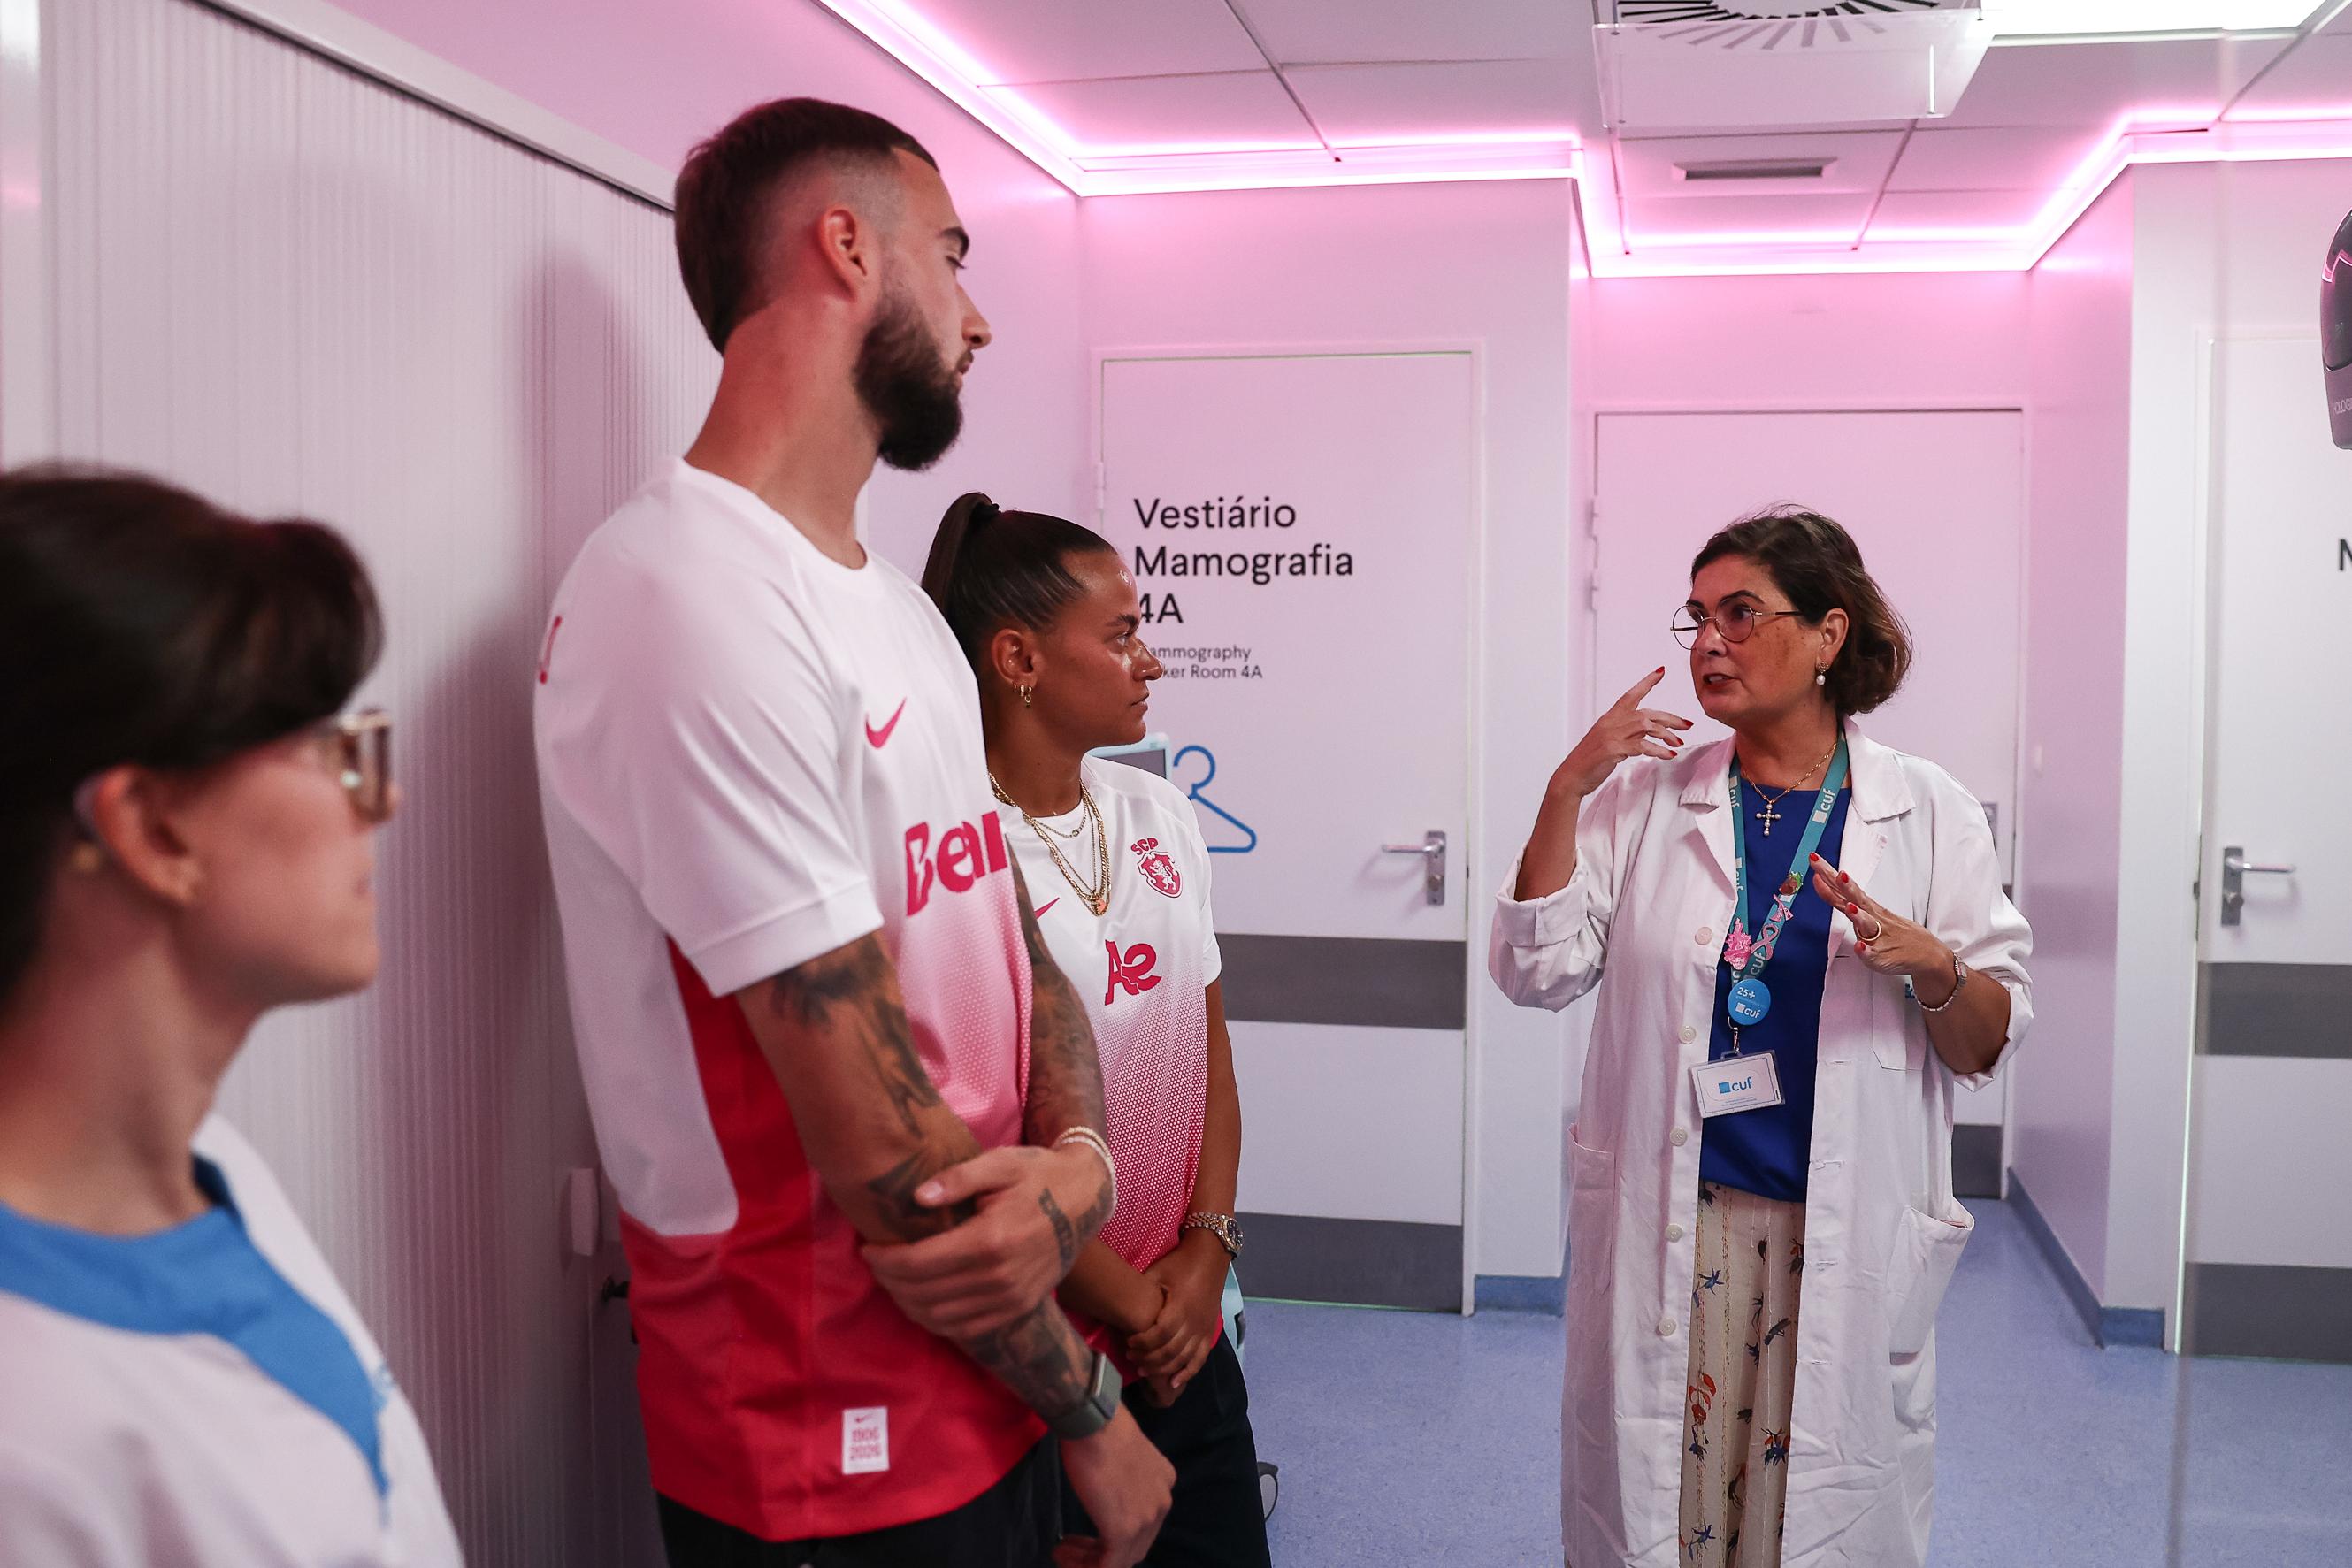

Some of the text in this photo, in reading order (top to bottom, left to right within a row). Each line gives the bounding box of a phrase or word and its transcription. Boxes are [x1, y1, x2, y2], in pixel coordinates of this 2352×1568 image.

[1134, 496, 1297, 529] Vestiário
[1135, 543, 1353, 585] Mamografia
[1139, 593, 1184, 623] 4A
[1150, 645, 1251, 662] ammography
[1162, 664, 1263, 679] ker Room 4A
[1820, 788, 1835, 811] cuf
[1130, 838, 1159, 855] SCP
[1736, 987, 1756, 999] 25+
[1744, 1008, 1761, 1019] cuf
[1731, 1076, 1752, 1091] cuf
